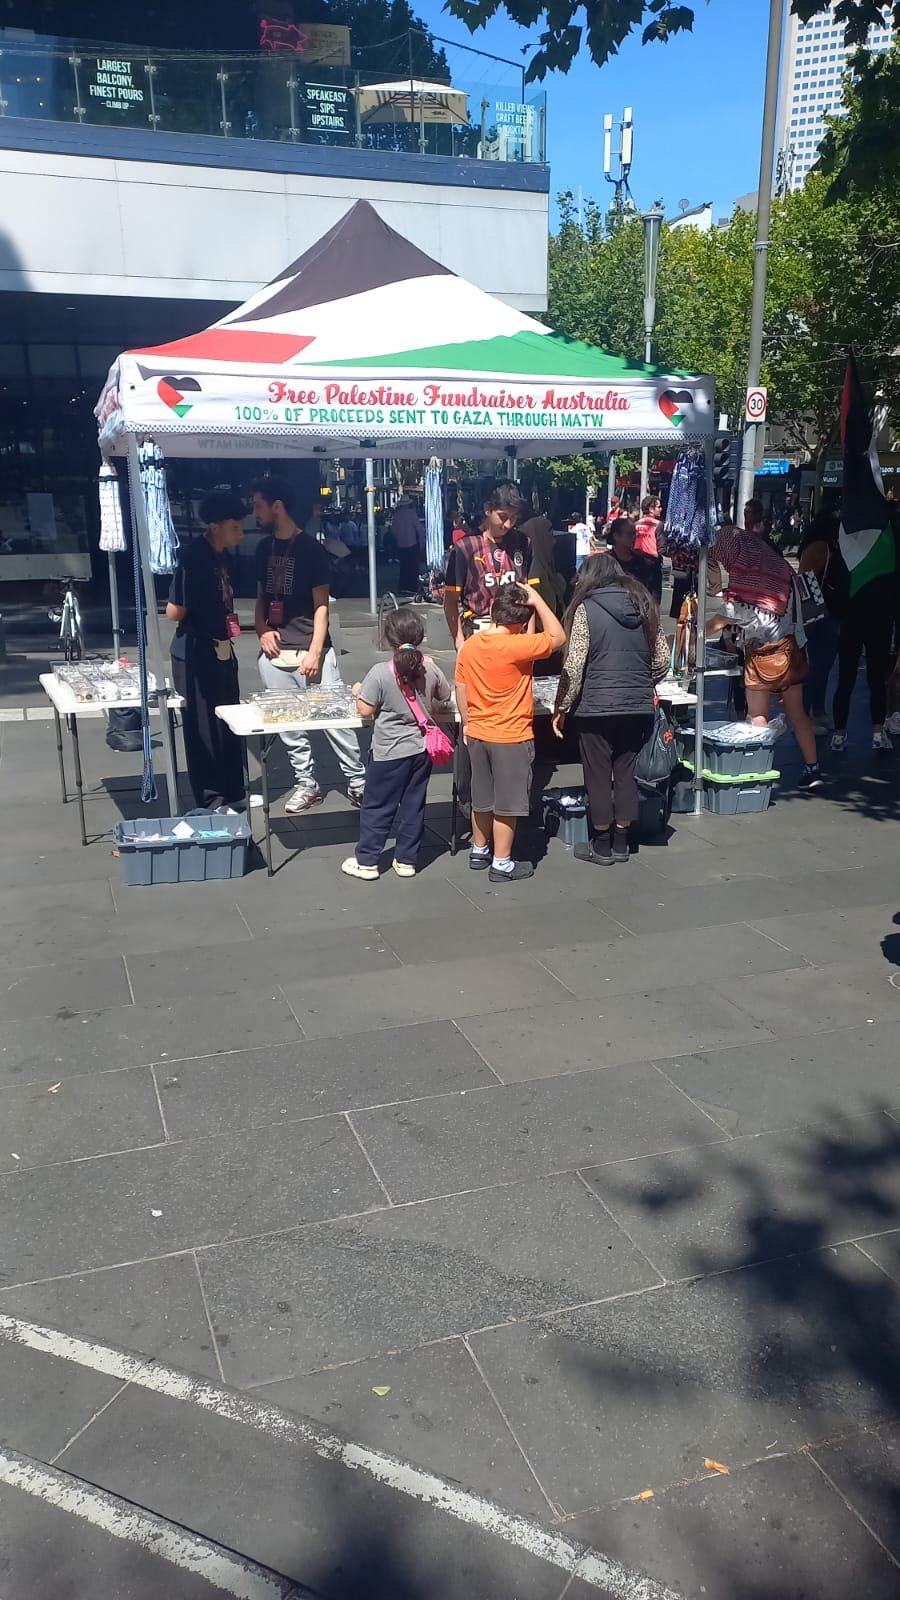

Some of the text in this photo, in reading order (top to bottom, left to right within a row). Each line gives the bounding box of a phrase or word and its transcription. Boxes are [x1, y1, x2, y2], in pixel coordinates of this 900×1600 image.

[97, 59, 131, 73] LARGEST
[97, 72, 134, 88] BALCONY,
[90, 85, 143, 100] FINEST POURS
[307, 89, 346, 102] SPEAKEASY
[320, 102, 335, 113] SIPS
[495, 101, 516, 113] KILLER
[312, 114, 344, 127] UPSTAIRS
[268, 381, 631, 411] Free Palestine Fundraiser Australia
[750, 398, 763, 410] 30
[235, 405, 604, 428] 100% OF PROCEEDS SENT TO GAZA THROUGH MATW
